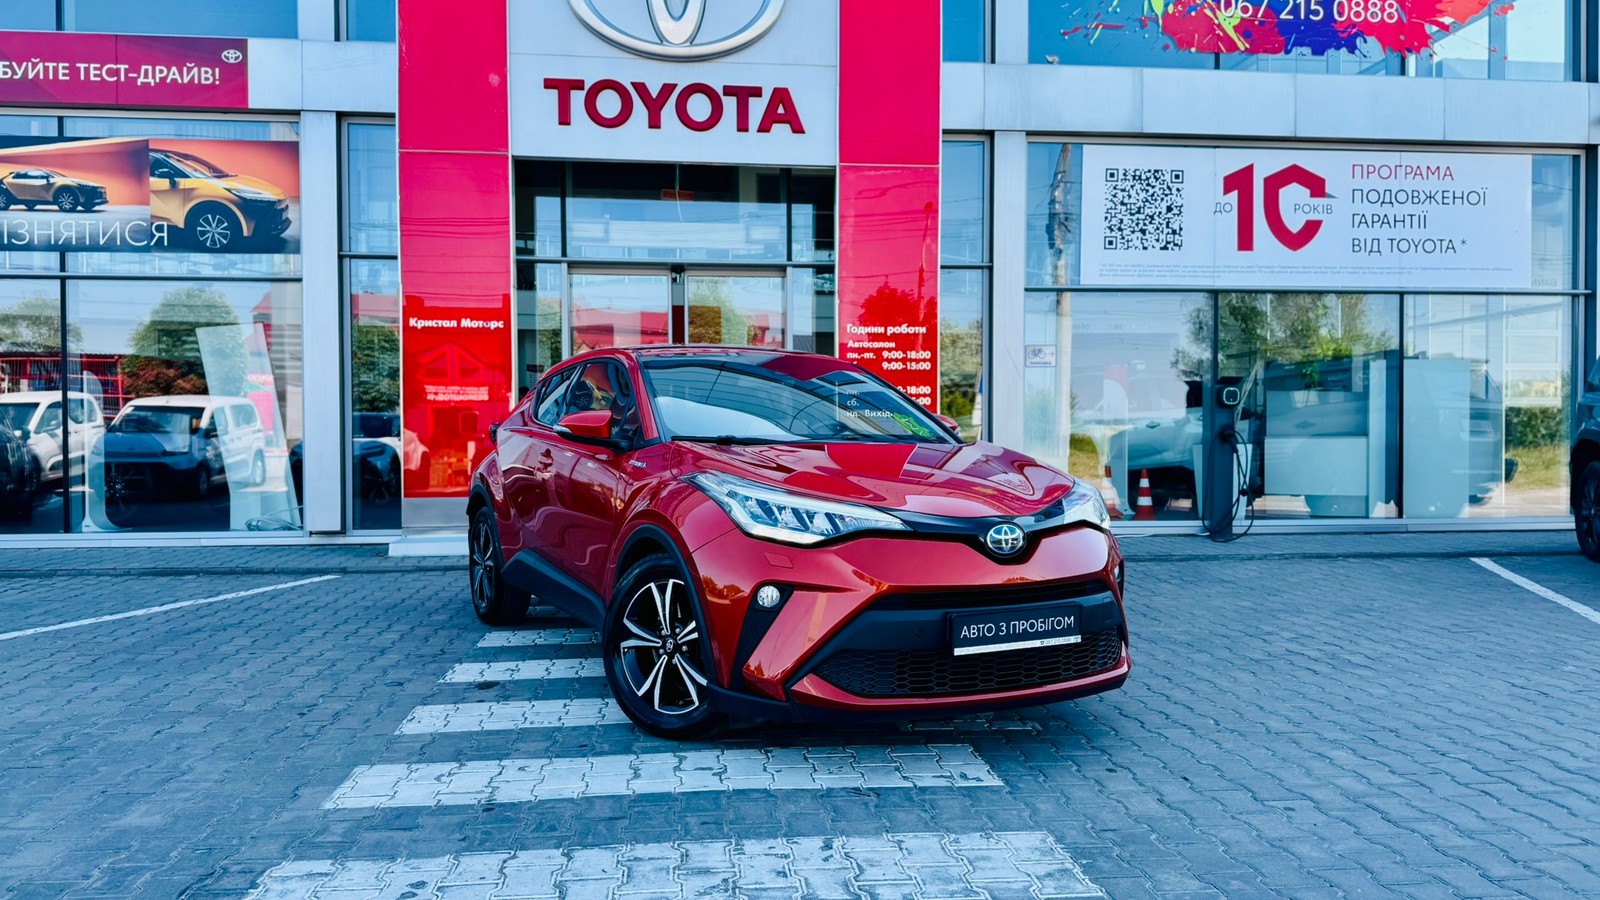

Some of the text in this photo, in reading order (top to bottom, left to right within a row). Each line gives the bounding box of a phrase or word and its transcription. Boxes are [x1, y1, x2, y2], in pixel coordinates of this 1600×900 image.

[1279, 0, 1324, 21] 215
[1333, 0, 1399, 24] 0888
[0, 58, 220, 86] БУЙТЕ ТЕСТ-ДРАЙВ!
[543, 77, 806, 135] TOYOTA
[1351, 163, 1455, 181] ПРОГРАМА
[1213, 162, 1333, 252] ДО 10 РОКІВ
[1351, 187, 1489, 208] ПОДОВЖЕНОЇ
[1351, 210, 1429, 229] ГАРАНТІЇ
[3, 219, 168, 247] ІЗНЯТИСЯ
[1351, 238, 1382, 256] ВІД
[409, 317, 504, 330] Кристал Моторс
[846, 324, 926, 336] Години роботи
[847, 340, 896, 348] Автосалон
[882, 350, 931, 359] 9:00-18:00
[882, 361, 931, 370] 9:00-15:00
[960, 623, 996, 639] АВТО
[1010, 615, 1075, 634] ПРОБІГОМ
